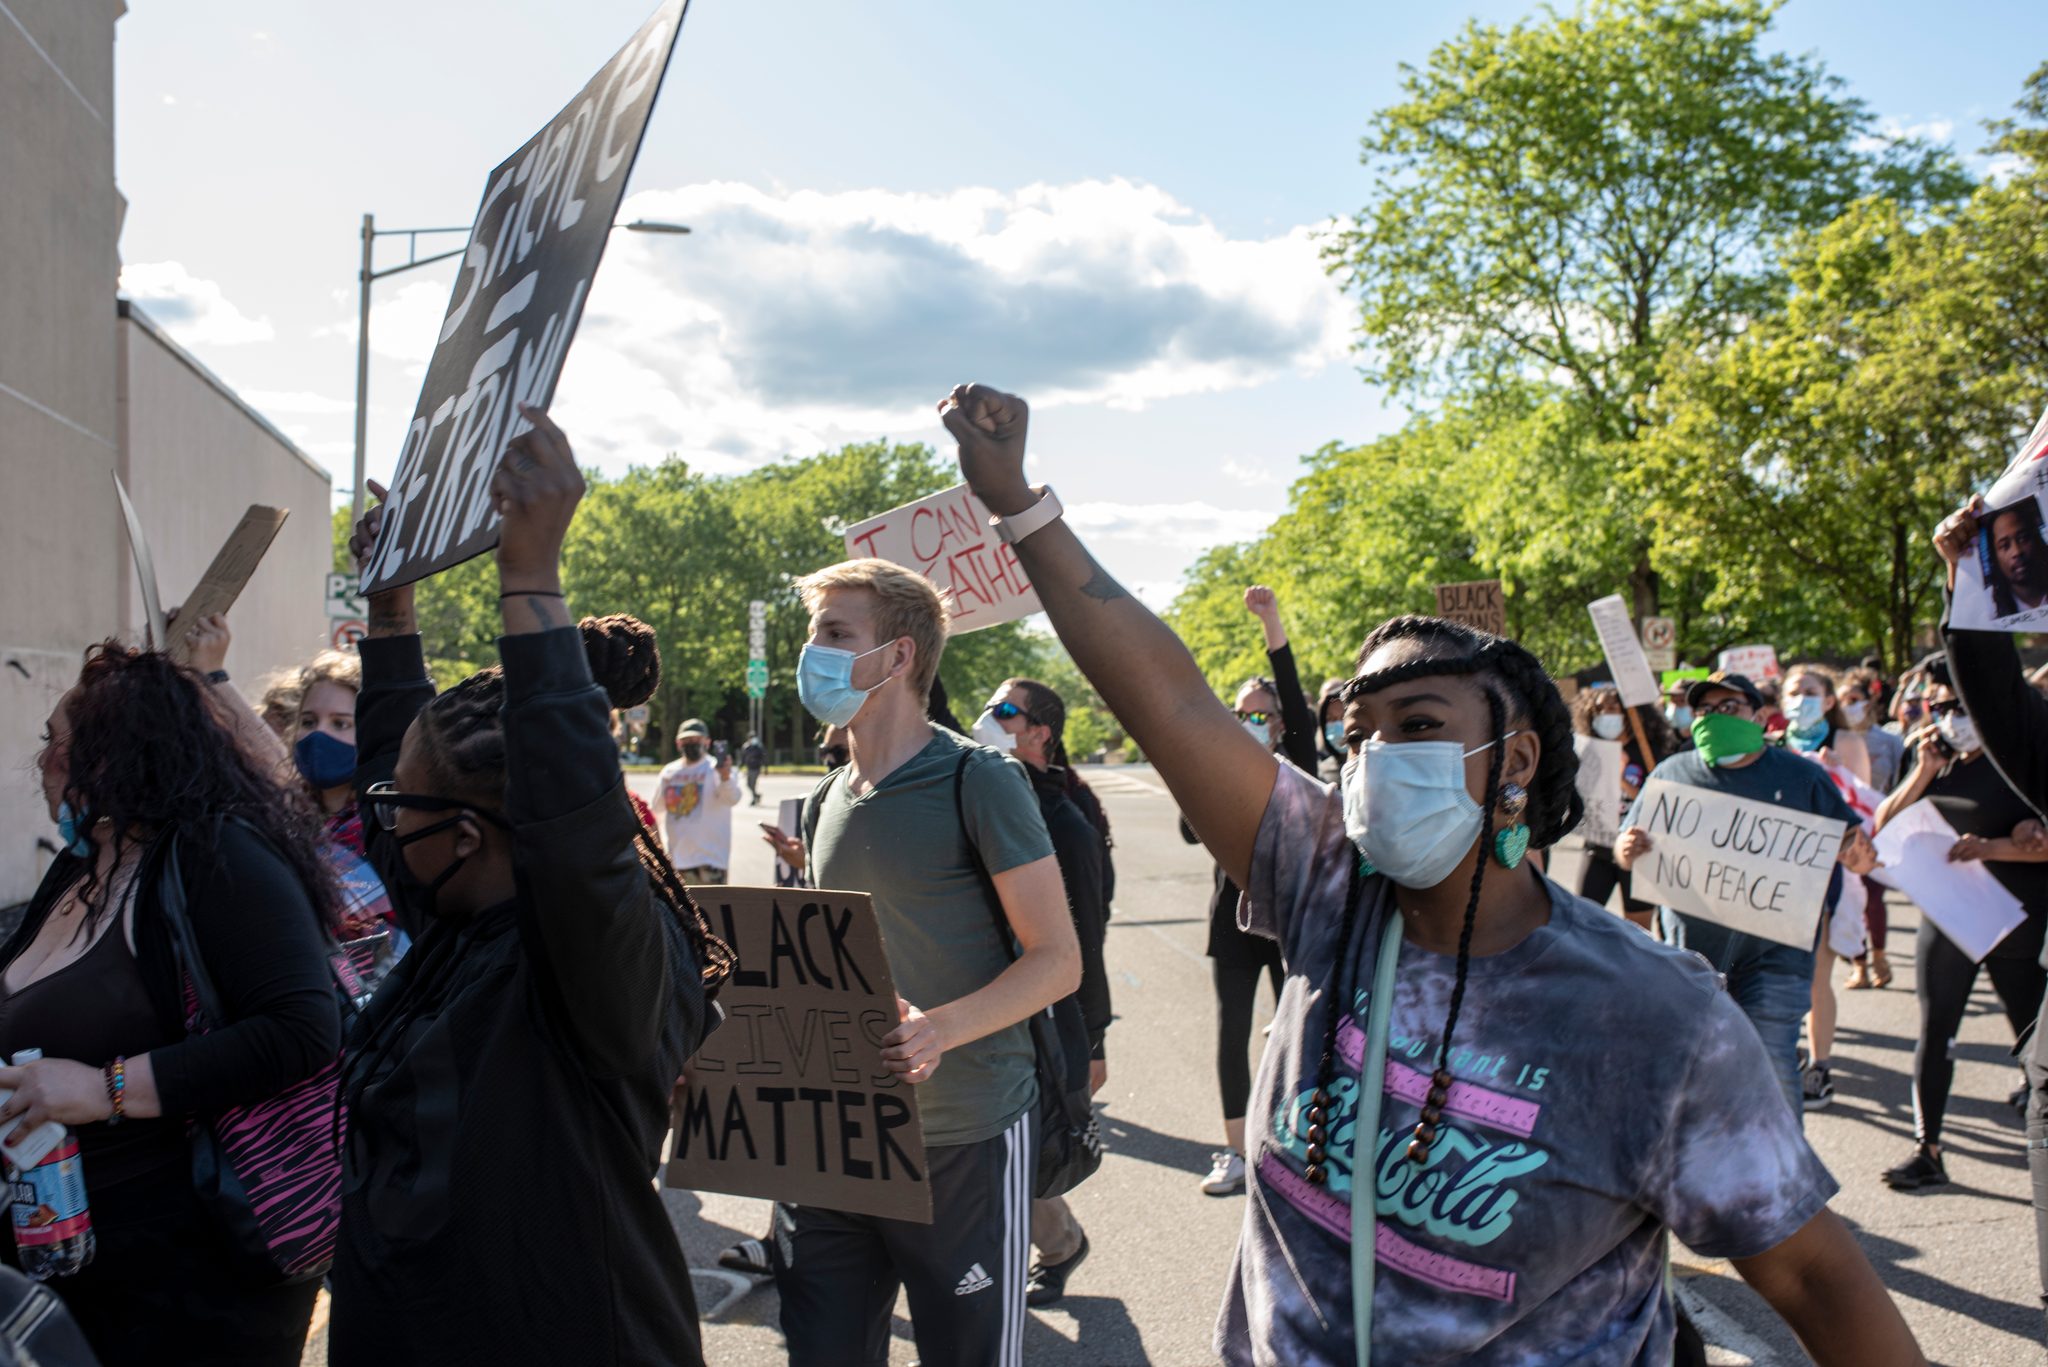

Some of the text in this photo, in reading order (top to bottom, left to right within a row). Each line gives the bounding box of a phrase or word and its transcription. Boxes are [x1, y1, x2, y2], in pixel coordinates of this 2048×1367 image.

[1440, 585, 1499, 612] BLACK
[1648, 792, 1703, 840] NO
[1711, 807, 1842, 870] JUSTICE
[1656, 852, 1791, 912] NO PEACE
[675, 1084, 922, 1182] MATTER
[954, 1276, 994, 1296] adidas
